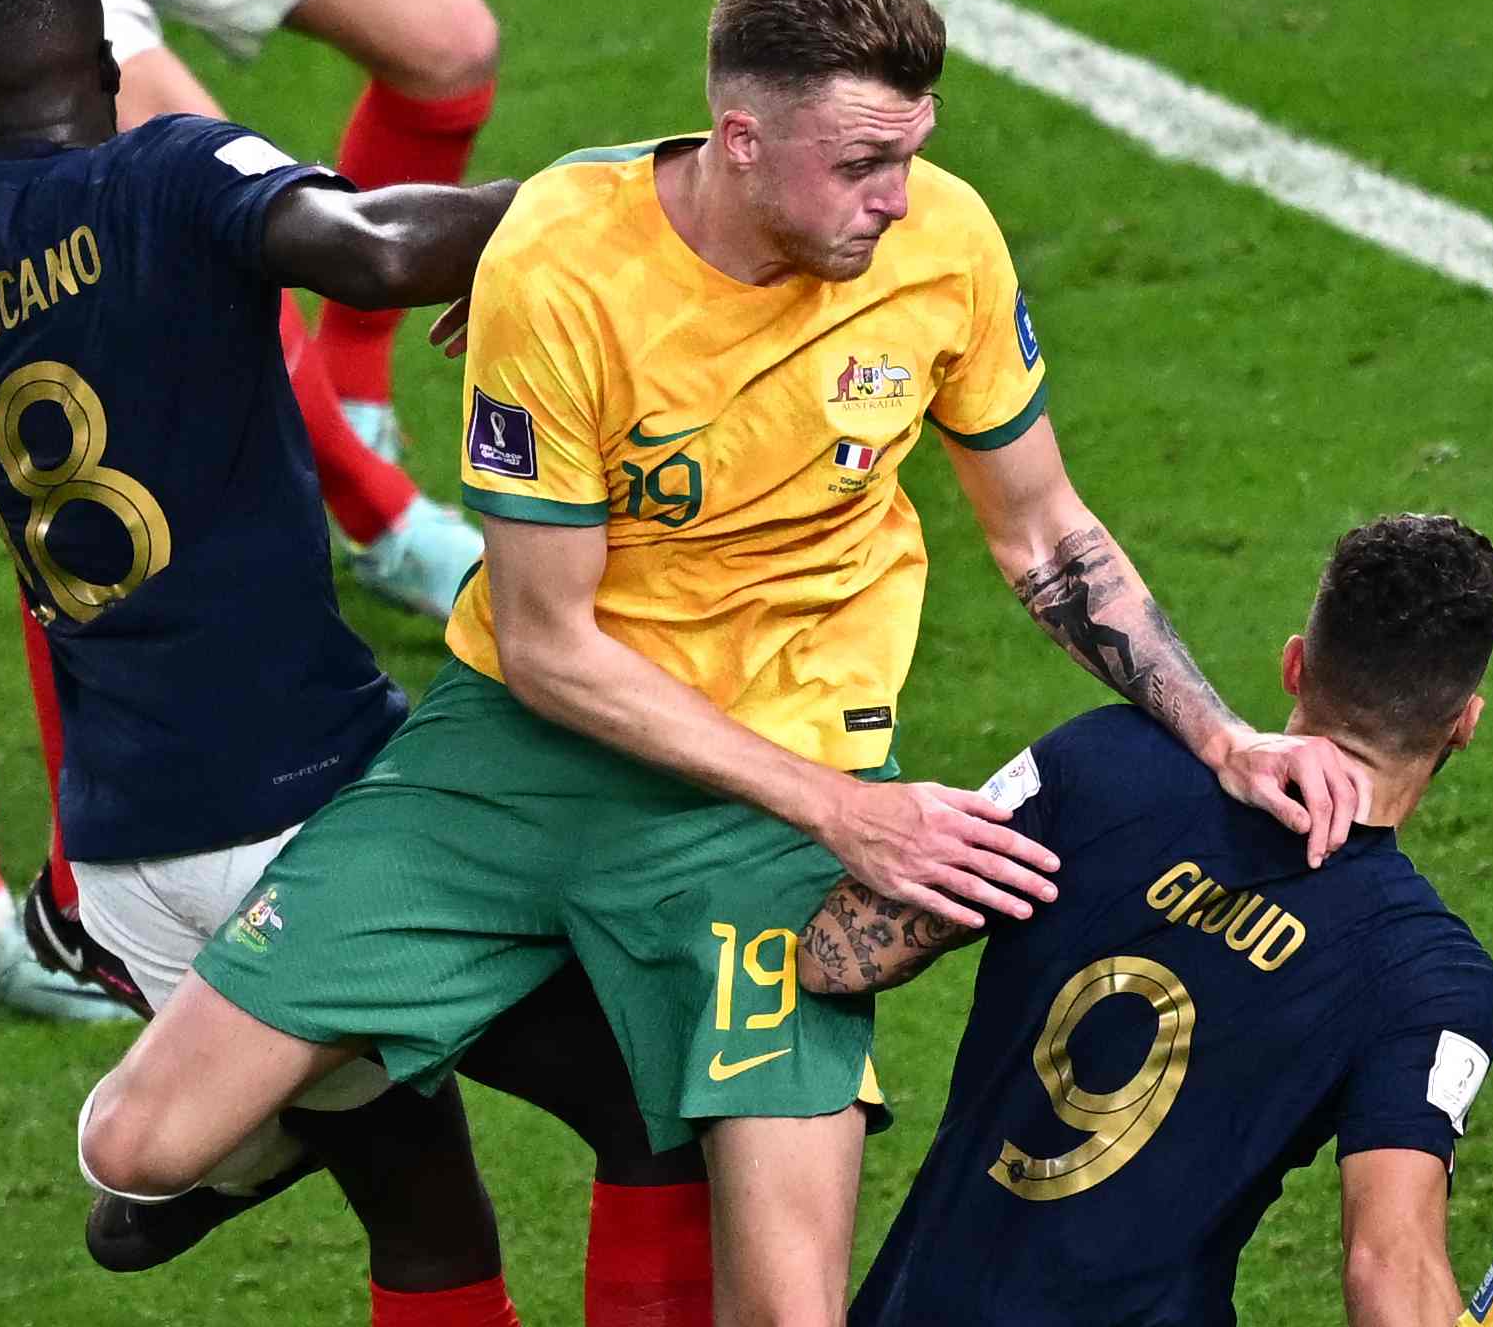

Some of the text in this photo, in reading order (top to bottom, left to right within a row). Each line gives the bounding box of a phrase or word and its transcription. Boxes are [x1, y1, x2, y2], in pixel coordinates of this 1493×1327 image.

[621, 452, 702, 528] 19
[712, 922, 798, 1031] 19
[987, 955, 1196, 1201] 9
